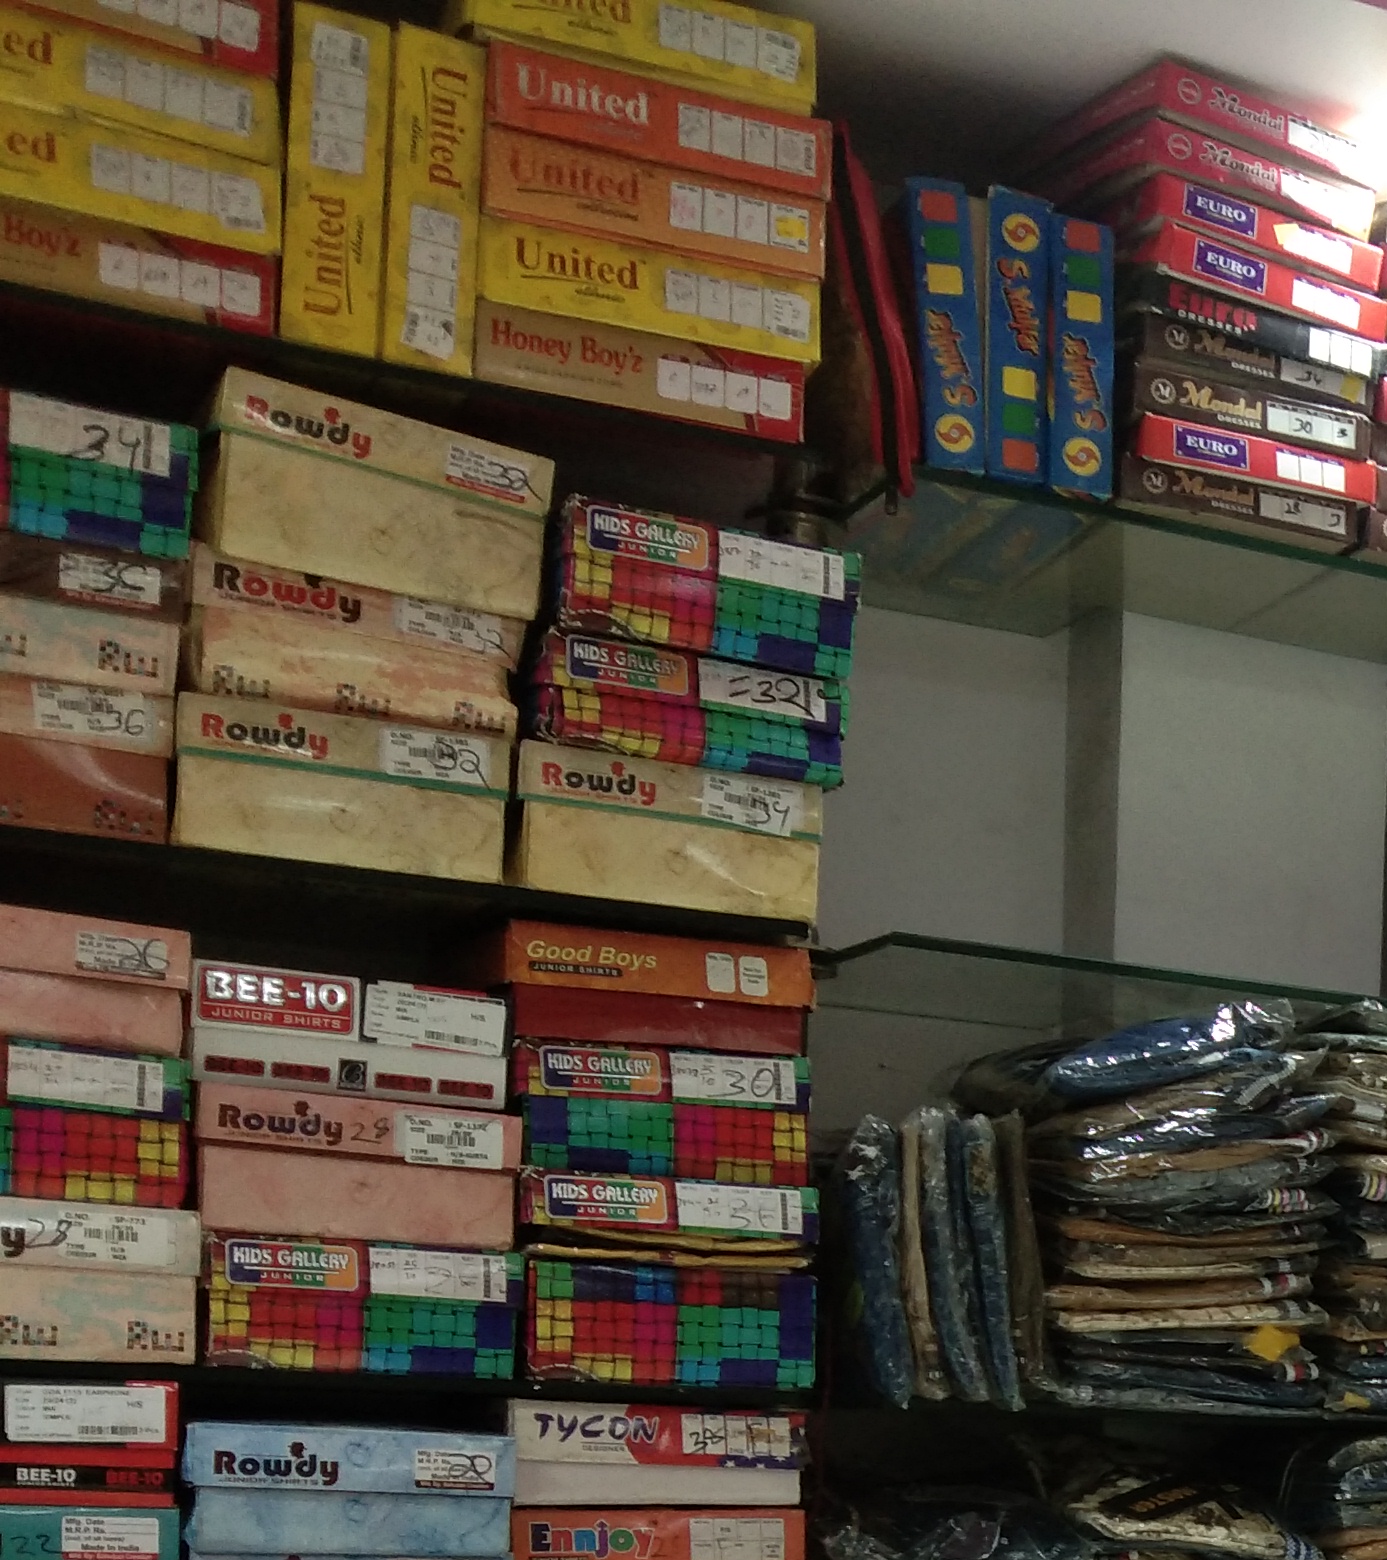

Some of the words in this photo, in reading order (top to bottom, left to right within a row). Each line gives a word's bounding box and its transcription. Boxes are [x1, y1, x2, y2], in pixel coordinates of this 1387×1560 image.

[516, 63, 650, 124] United
[1208, 87, 1284, 133] Mondal
[429, 67, 467, 189] United
[509, 149, 641, 206] United
[1196, 196, 1247, 222] EURO
[515, 237, 639, 289] United
[1206, 251, 1256, 278] EURO
[1180, 380, 1262, 420] Mondal
[245, 395, 372, 458] Rowdy
[1185, 435, 1238, 457] EURO
[593, 513, 630, 535] KIDS
[635, 521, 700, 549] GALLERY
[597, 669, 657, 683] JUNIOR
[201, 714, 329, 759] Rowdy
[541, 761, 656, 805] Rowdy
[526, 940, 592, 962] Good
[599, 947, 658, 969] Boys
[205, 970, 347, 1012] BEE-10
[572, 1076, 631, 1086] JUNIOR
[218, 1101, 342, 1145] Rowdy
[577, 1206, 636, 1217] JUNIOR
[260, 1271, 324, 1282] JUNIOR
[534, 1412, 659, 1442] TYCON
[16, 1468, 77, 1482] BEE-10
[106, 1469, 164, 1485] BEE-10
[213, 1442, 339, 1486] Rowdy
